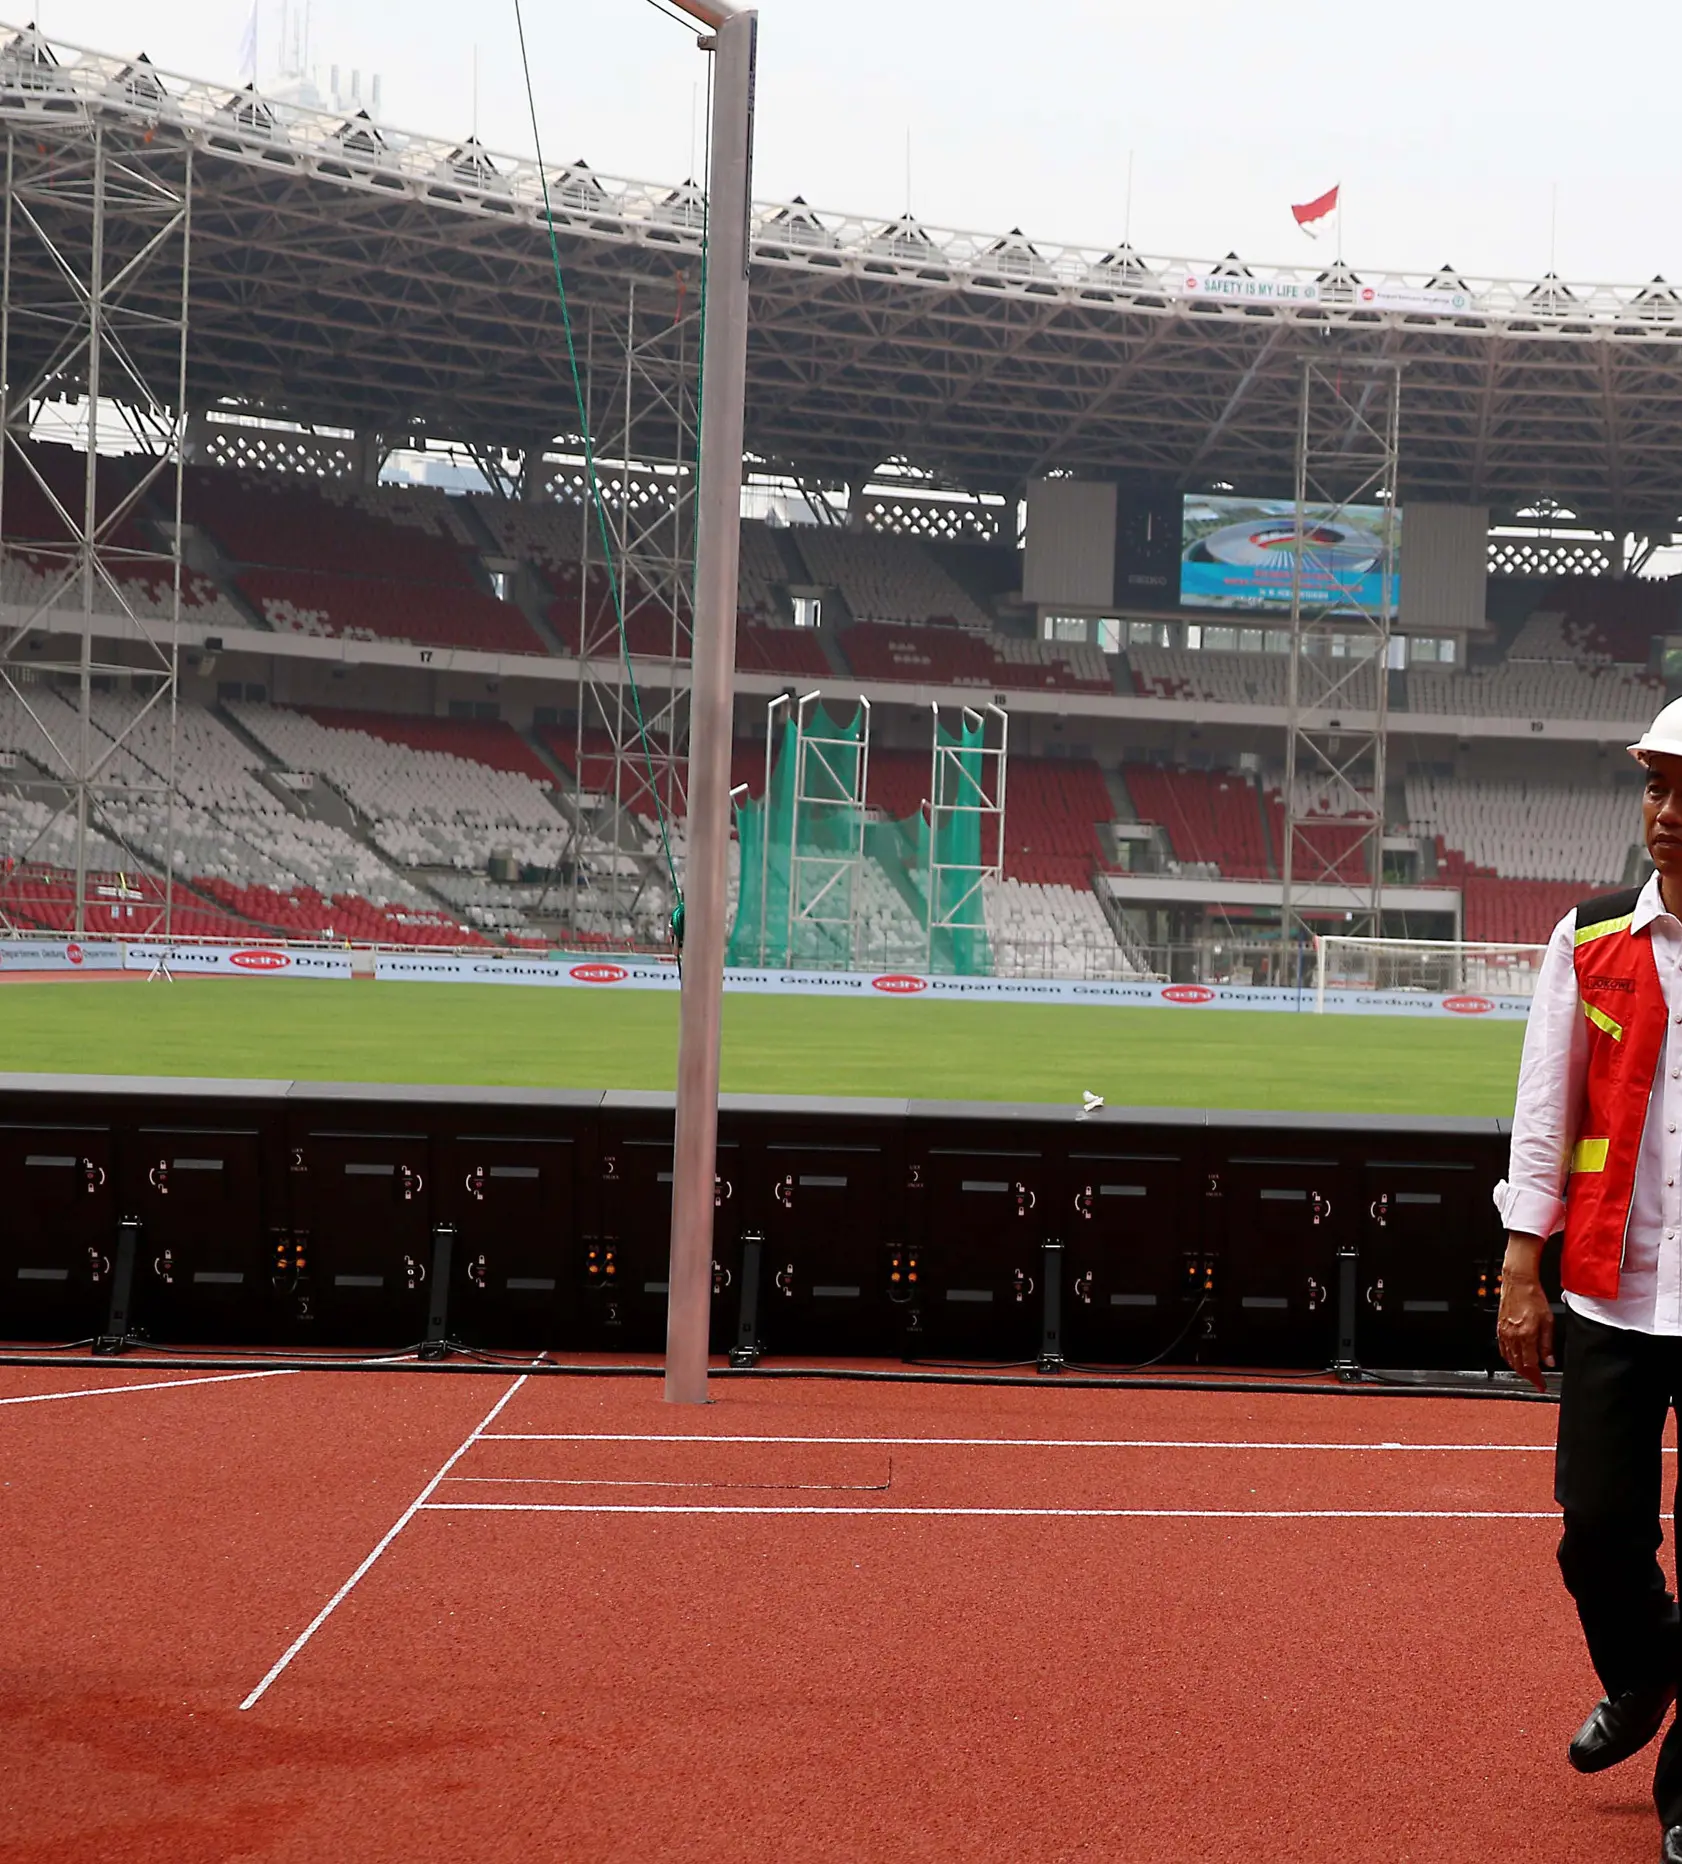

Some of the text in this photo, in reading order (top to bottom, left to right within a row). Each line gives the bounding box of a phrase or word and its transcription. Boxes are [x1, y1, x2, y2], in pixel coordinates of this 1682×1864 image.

[1204, 279, 1241, 294] SAFETY
[1246, 283, 1255, 294] IS
[1258, 284, 1274, 295] MY
[1277, 285, 1298, 298] LIFE
[420, 651, 433, 662] 17
[473, 965, 559, 978] Gedung
[780, 974, 862, 988] Gedung
[932, 980, 1061, 994] Departemen
[1073, 985, 1152, 999] Gedung
[1356, 996, 1433, 1009] Gedung
